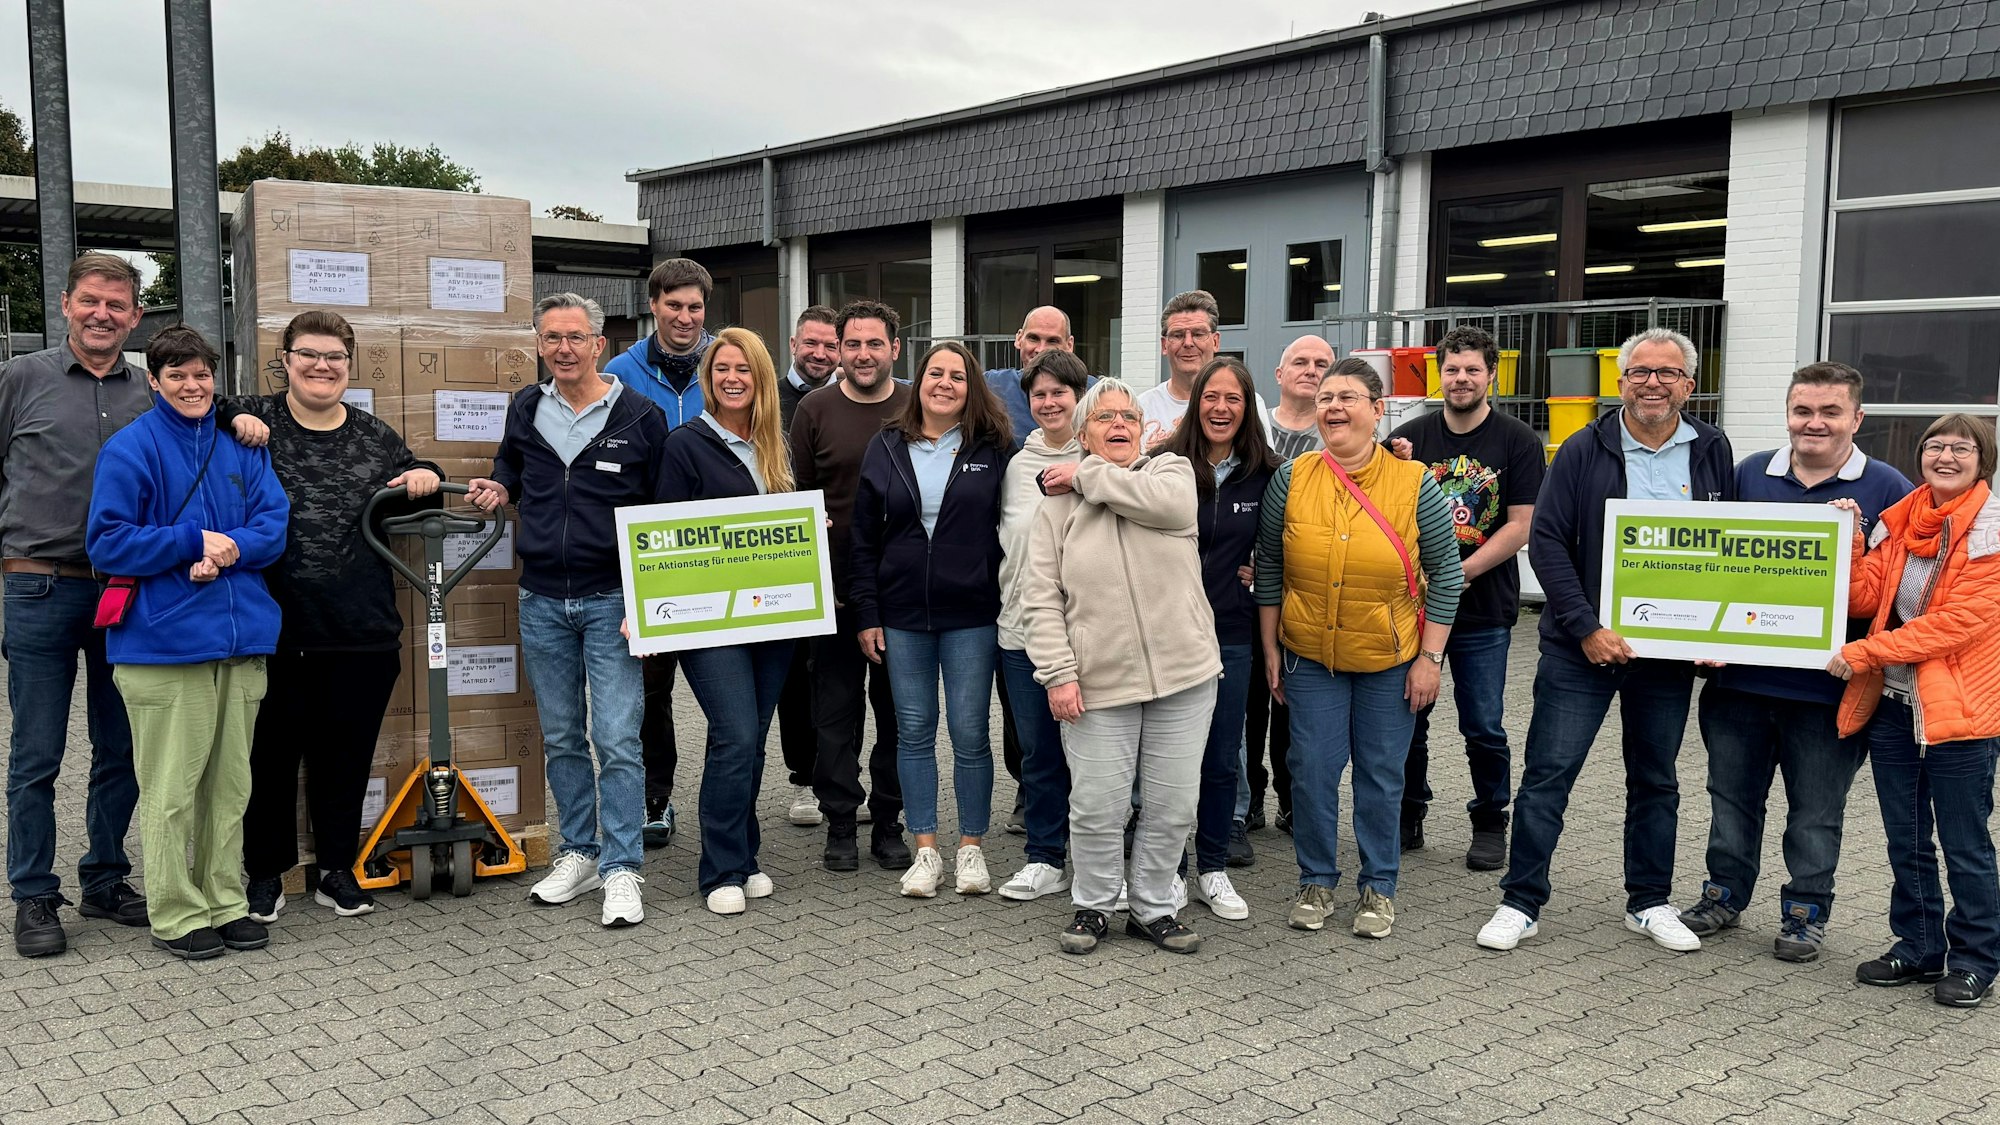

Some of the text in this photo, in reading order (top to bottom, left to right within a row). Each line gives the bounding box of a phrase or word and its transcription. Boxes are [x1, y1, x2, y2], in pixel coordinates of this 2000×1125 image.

[636, 525, 810, 550] SCHICHT WECHSEL
[1623, 526, 1828, 560] SCHICHT WECHSEL
[658, 559, 710, 570] Aktionstag
[712, 556, 724, 565] für
[752, 549, 812, 561] Perspektiven
[1622, 559, 1827, 576] Der Aktionstag für neue Perspektiven
[1761, 612, 1794, 620] Pronova
